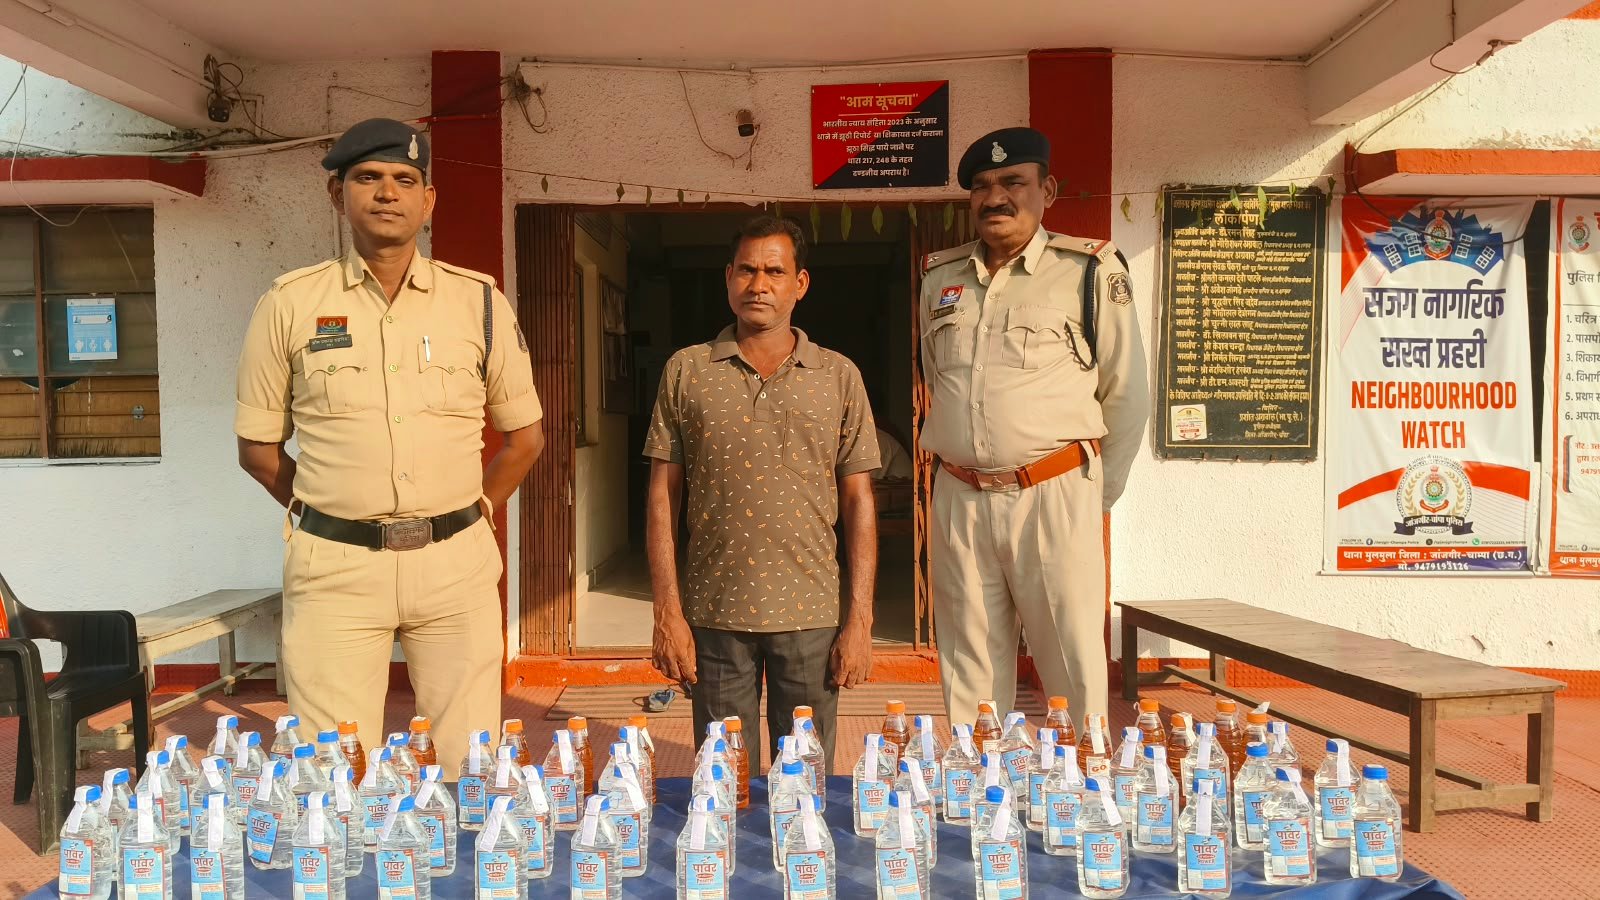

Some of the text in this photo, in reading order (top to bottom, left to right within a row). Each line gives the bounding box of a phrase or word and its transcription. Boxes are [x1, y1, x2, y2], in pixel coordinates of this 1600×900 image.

[914, 118, 938, 127] अनुसार
[1214, 210, 1260, 226] लोकार्पण
[1568, 270, 1594, 285] पुलिस
[1363, 279, 1506, 319] सजग नागरिक
[1575, 312, 1597, 324] चरित्र
[1567, 332, 1600, 343] 2. पासपो
[1436, 328, 1488, 369] प्रहरी
[1567, 354, 1573, 362] 3.
[1566, 373, 1574, 381] 4.
[1351, 381, 1517, 409] NEIGHBOURHOOD
[1566, 392, 1594, 401] 5. प्रथम
[1565, 412, 1573, 420] 6.
[1401, 421, 1466, 449] WATCH
[1344, 551, 1363, 559] थाना
[1365, 551, 1396, 562] मुलमुला
[1399, 549, 1421, 559] जिला
[952, 779, 972, 787] पावर
[238, 787, 255, 795] पावर
[464, 785, 480, 793] पावर
[550, 785, 570, 793] पावर
[865, 789, 884, 798] पावर
[1053, 802, 1074, 811] पावर
[1328, 798, 1350, 806] पावर
[367, 804, 389, 813] पावर
[1145, 804, 1166, 812] पावर
[252, 818, 272, 830] पावर
[1276, 831, 1300, 840] पावर
[1363, 831, 1387, 840] पावर
[1091, 844, 1115, 853] पावर
[1193, 845, 1218, 854] पावर
[64, 850, 84, 859] पावर
[988, 853, 1012, 863] पावर
[130, 858, 154, 868] पावर
[193, 857, 214, 867] पावर
[300, 858, 320, 867] पावर
[384, 862, 405, 870] पावर
[884, 858, 908, 868] पावर
[484, 862, 509, 872] पावर
[576, 863, 598, 873] पावर
[693, 863, 717, 873] पावर
[795, 864, 818, 874] पावर
